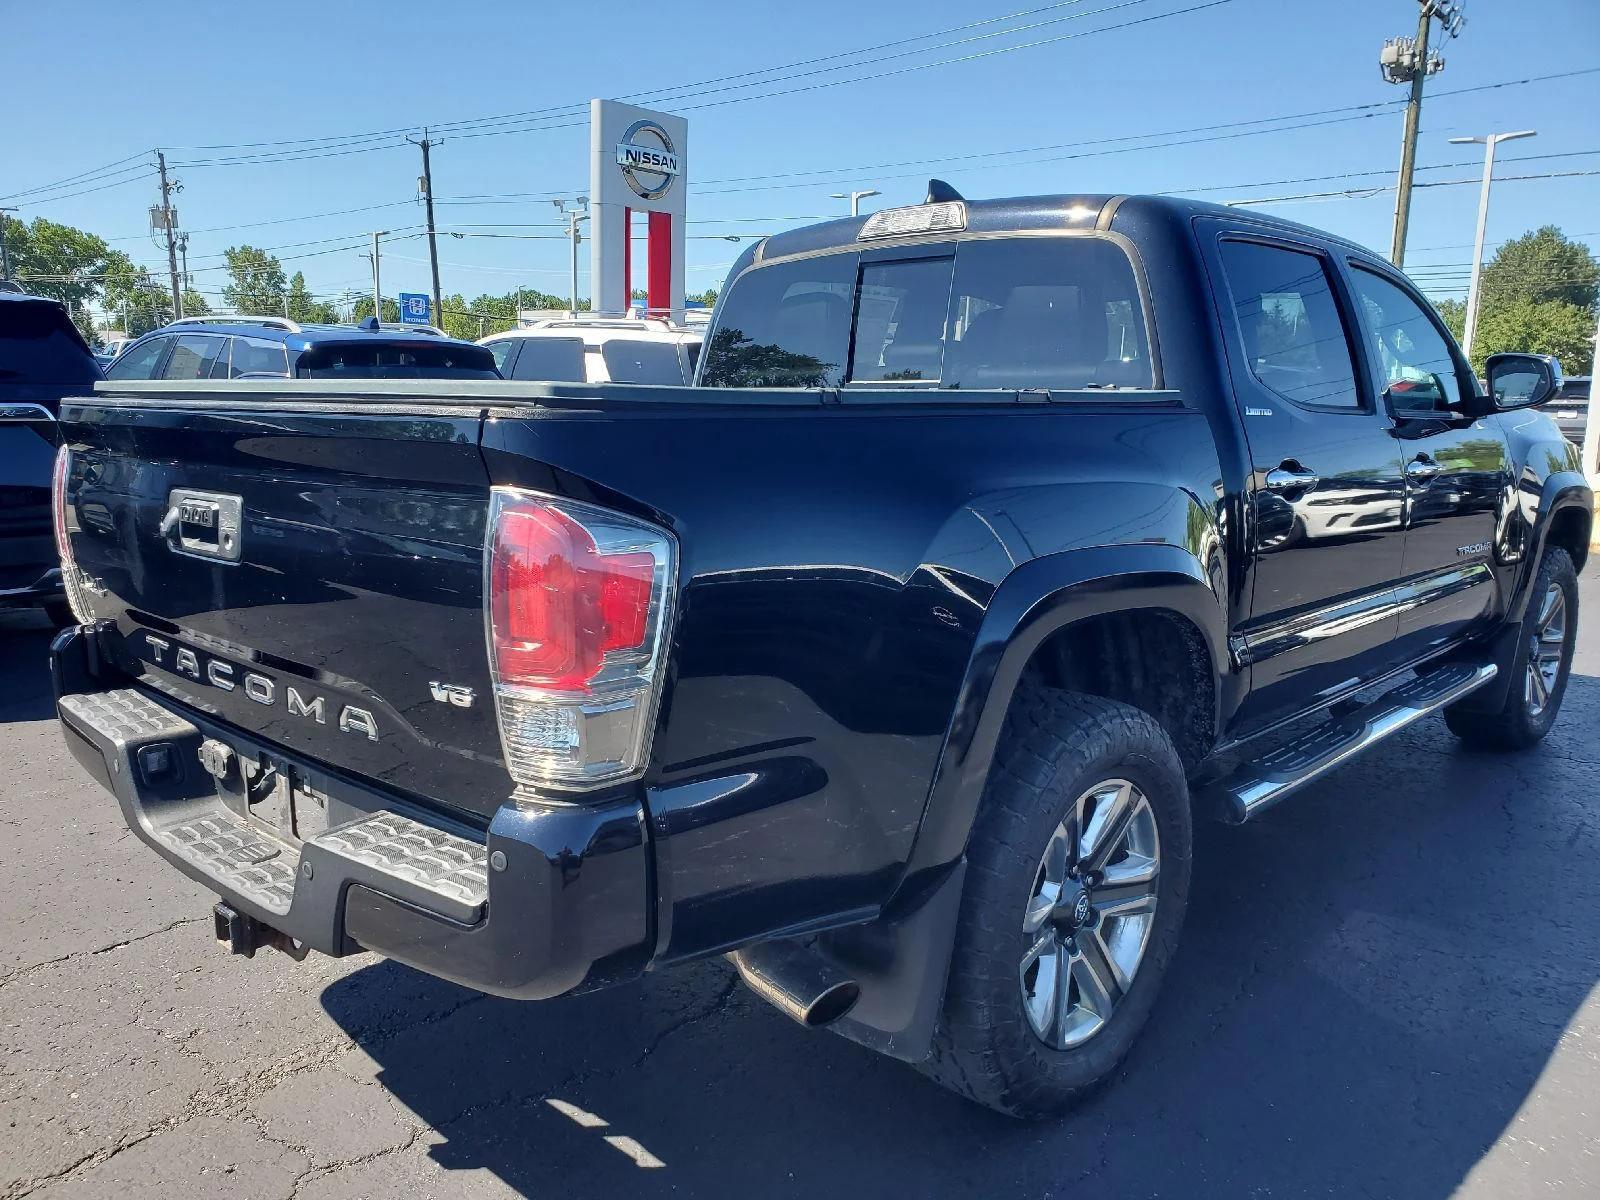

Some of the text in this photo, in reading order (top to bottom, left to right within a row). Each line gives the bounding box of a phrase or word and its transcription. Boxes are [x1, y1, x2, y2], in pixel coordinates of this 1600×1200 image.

[625, 149, 677, 171] NISSAN
[1457, 541, 1491, 555] TACOMA
[145, 634, 379, 742] TACOMA
[429, 680, 475, 708] V6
